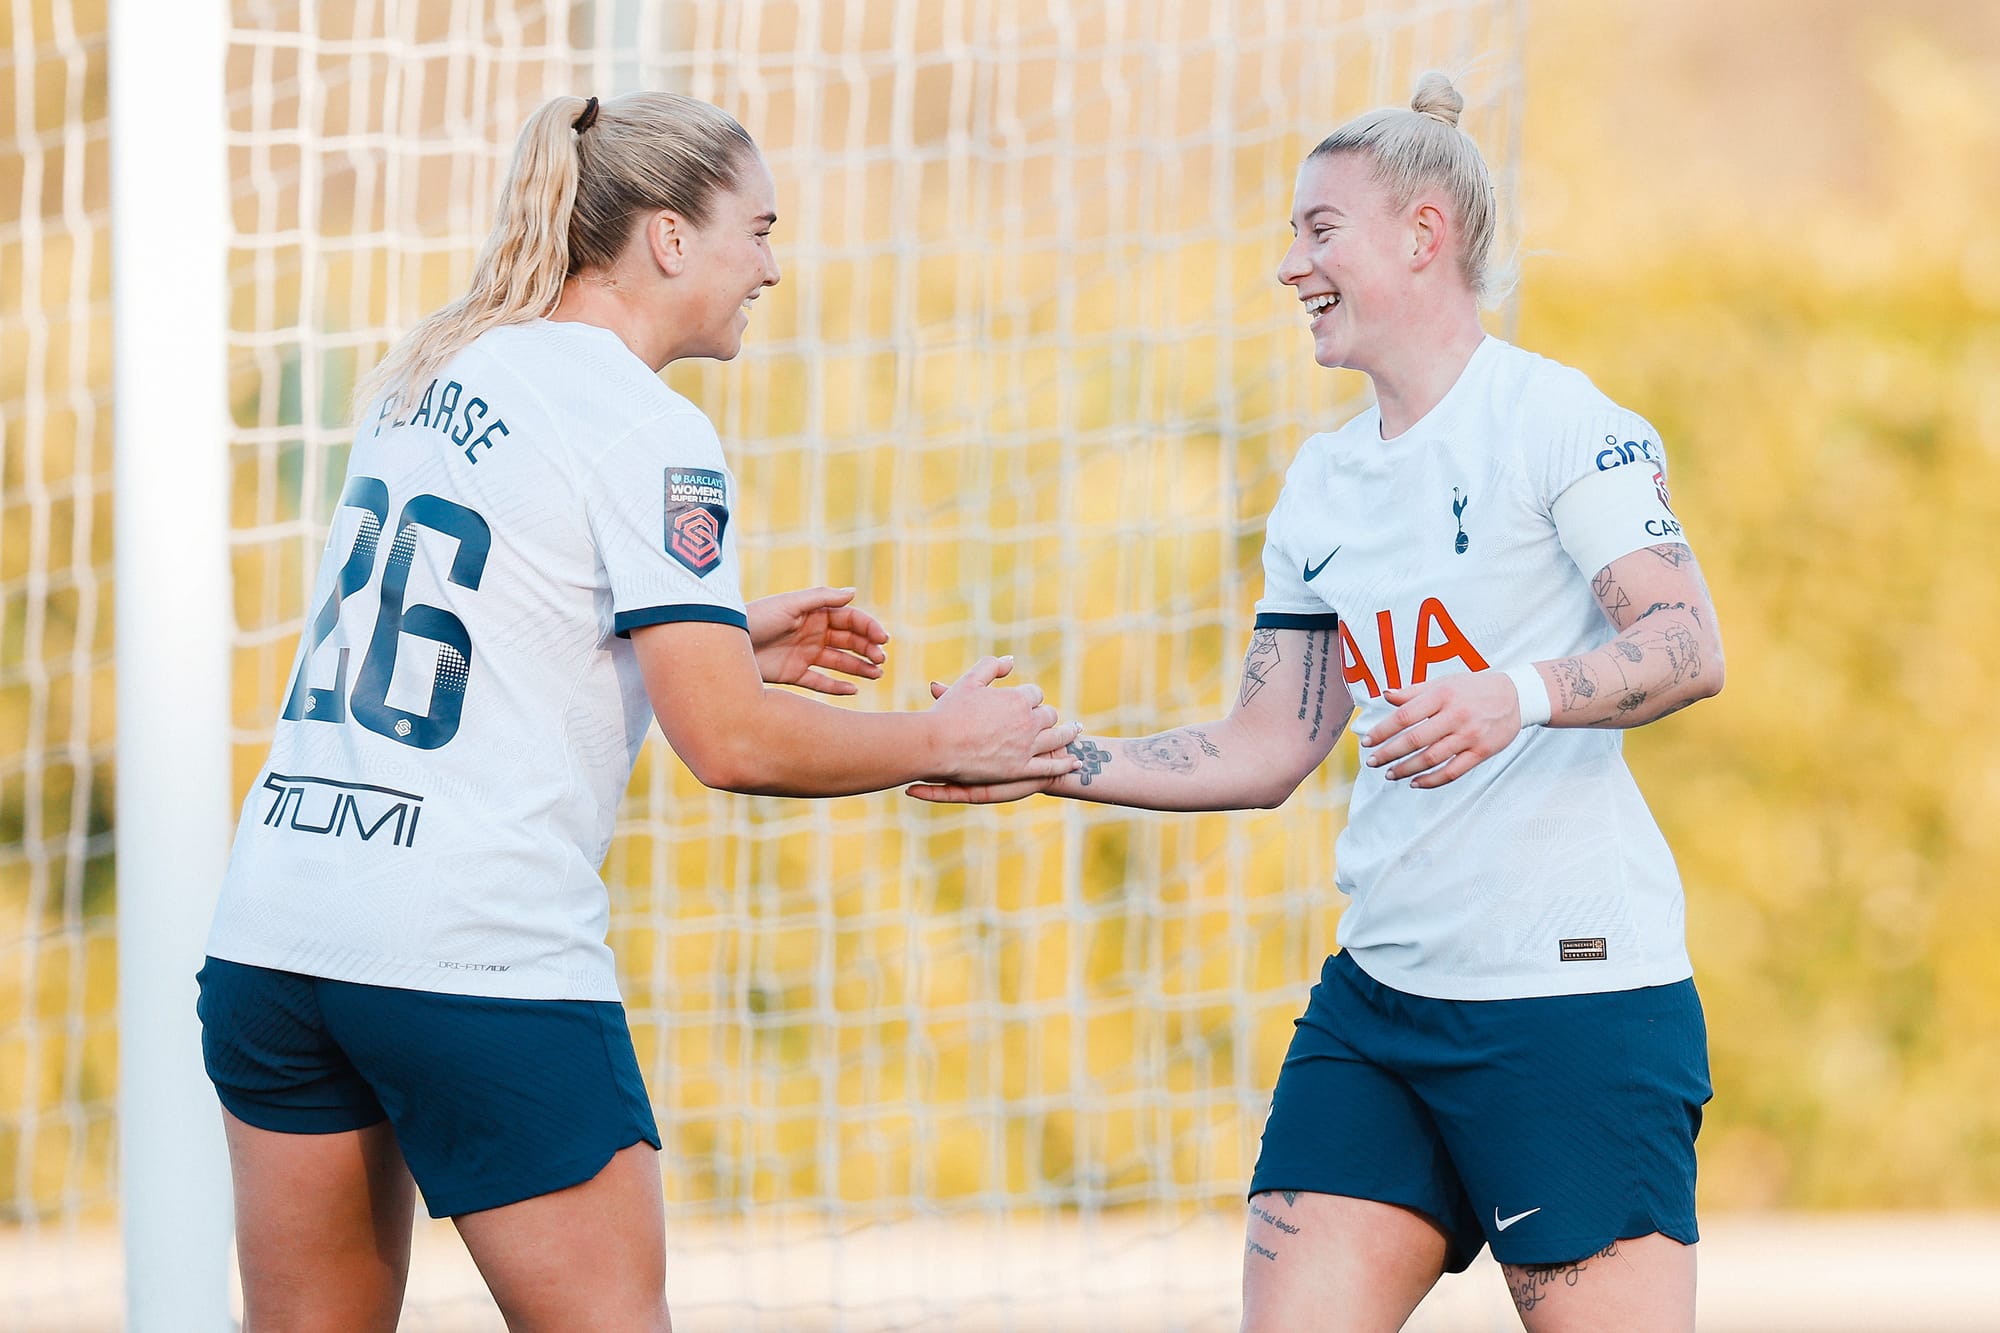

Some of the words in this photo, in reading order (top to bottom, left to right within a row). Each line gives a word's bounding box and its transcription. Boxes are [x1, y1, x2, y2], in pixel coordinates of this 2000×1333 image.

[1596, 435, 1660, 471] cin
[671, 485, 723, 499] WOMEN'S
[683, 475, 723, 488] BARCLAYS
[671, 495, 698, 503] SUPER
[1645, 519, 1682, 536] CAP
[281, 475, 492, 750] 26
[1339, 597, 1490, 698] AIA
[263, 772, 424, 848] TUMI
